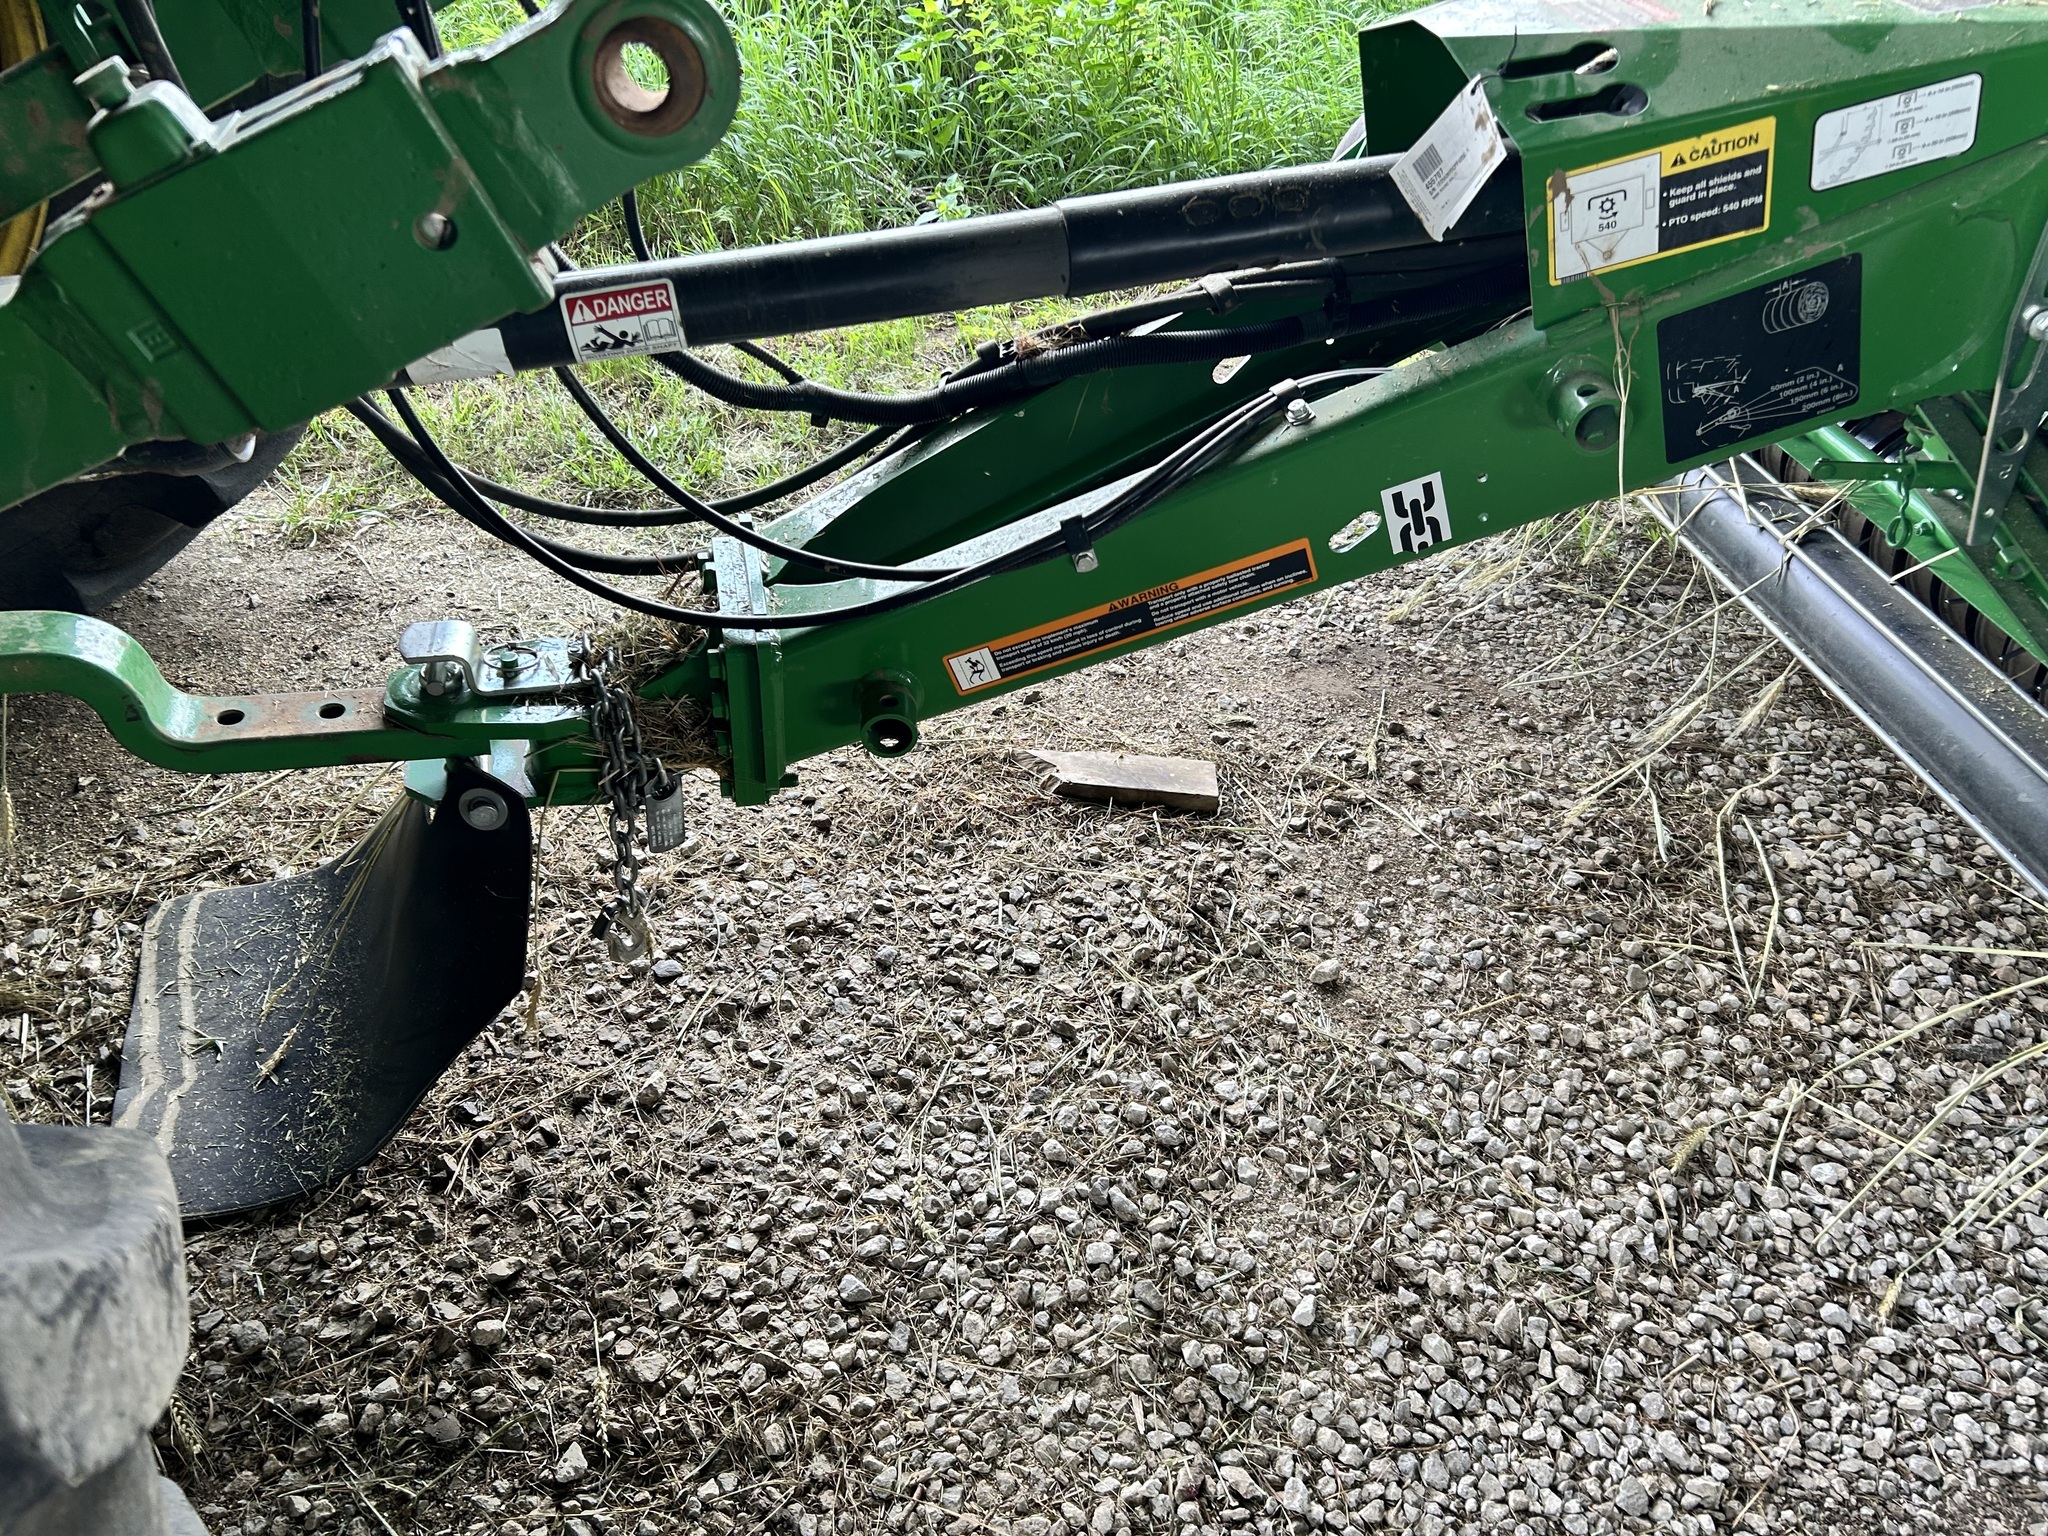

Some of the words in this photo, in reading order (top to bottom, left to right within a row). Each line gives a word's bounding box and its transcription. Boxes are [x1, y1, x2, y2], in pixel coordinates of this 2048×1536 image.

[1689, 132, 1760, 162] CAUTION
[1669, 183, 1693, 197] Keep
[1695, 179, 1706, 190] all
[1708, 170, 1742, 186] shields
[1744, 164, 1762, 177] and
[1669, 192, 1696, 208] guard
[1698, 189, 1706, 199] in
[1708, 183, 1736, 198] place.
[1668, 215, 1688, 227] PTO
[1690, 206, 1720, 222] speed:
[1722, 201, 1739, 213] 540
[1741, 194, 1762, 208] RPM
[1598, 220, 1618, 232] 540
[1782, 281, 1788, 290] A
[593, 289, 670, 318] DANGER
[1770, 380, 1794, 392] 50mm
[1796, 376, 1804, 384] (2
[1806, 371, 1820, 380] in.)
[1837, 364, 1844, 372] A
[1734, 384, 1740, 394] A
[1779, 385, 1807, 399] 100mm
[1809, 380, 1817, 389] (4
[1819, 376, 1832, 385] in.)
[1790, 391, 1819, 405] 150mm
[1820, 387, 1828, 395] (6
[1830, 382, 1844, 391] in.)
[1802, 398, 1831, 412] 200mm
[1118, 582, 1179, 608] WARNING
[1147, 594, 1173, 605] Transport
[1202, 577, 1226, 587] properly
[1251, 562, 1270, 570] tractor
[1164, 594, 1187, 605] properly
[1186, 586, 1210, 597] attached
[1210, 581, 1228, 589] safety
[1238, 572, 1256, 580] chain.
[1169, 598, 1194, 610] transport
[1211, 588, 1228, 596] motor
[1228, 581, 1249, 590] vehicle.
[1153, 612, 1173, 622] Reduce
[1174, 607, 1191, 615] speed
[1212, 590, 1240, 602] additional
[1239, 584, 1260, 594] caution
[1260, 578, 1276, 587] when
[1173, 612, 1189, 620] under
[1189, 605, 1211, 615] adverse
[1210, 598, 1231, 608] surface
[1272, 577, 1295, 588] turning.
[995, 650, 1020, 661] transport
[1020, 644, 1036, 653] speed
[1072, 628, 1088, 636] mph).
[998, 655, 1026, 668] Exceeding
[1036, 647, 1053, 655] speed
[1064, 638, 1080, 646] result
[1104, 623, 1123, 633] control
[1123, 618, 1142, 627] during
[1011, 641, 1030, 650] exceed
[1072, 619, 1098, 630] maximum
[1000, 661, 1025, 672] transport
[1031, 653, 1051, 663] braking
[1062, 643, 1081, 652] serious
[1081, 638, 1098, 646] injury
[1104, 630, 1120, 638] death.
